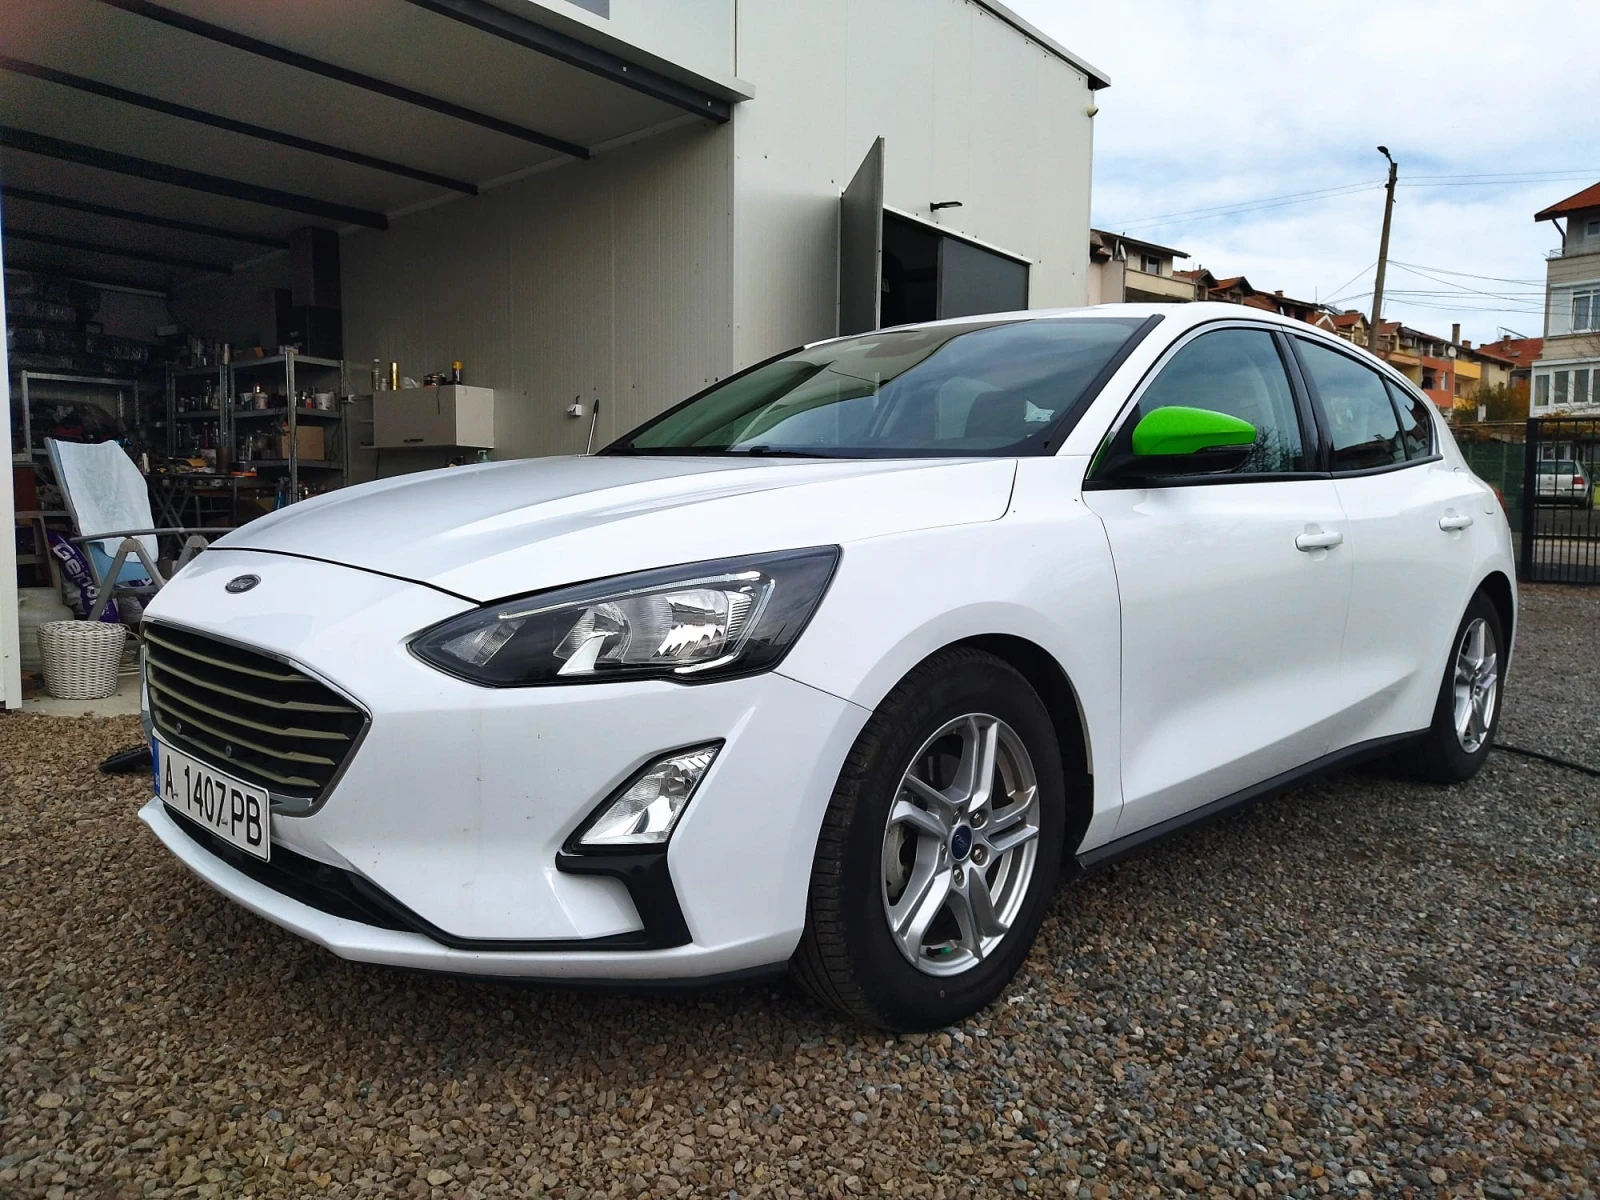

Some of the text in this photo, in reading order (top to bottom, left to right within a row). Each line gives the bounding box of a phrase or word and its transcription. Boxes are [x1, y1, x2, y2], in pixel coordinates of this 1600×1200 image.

[165, 754, 263, 847] A 1407 PB
